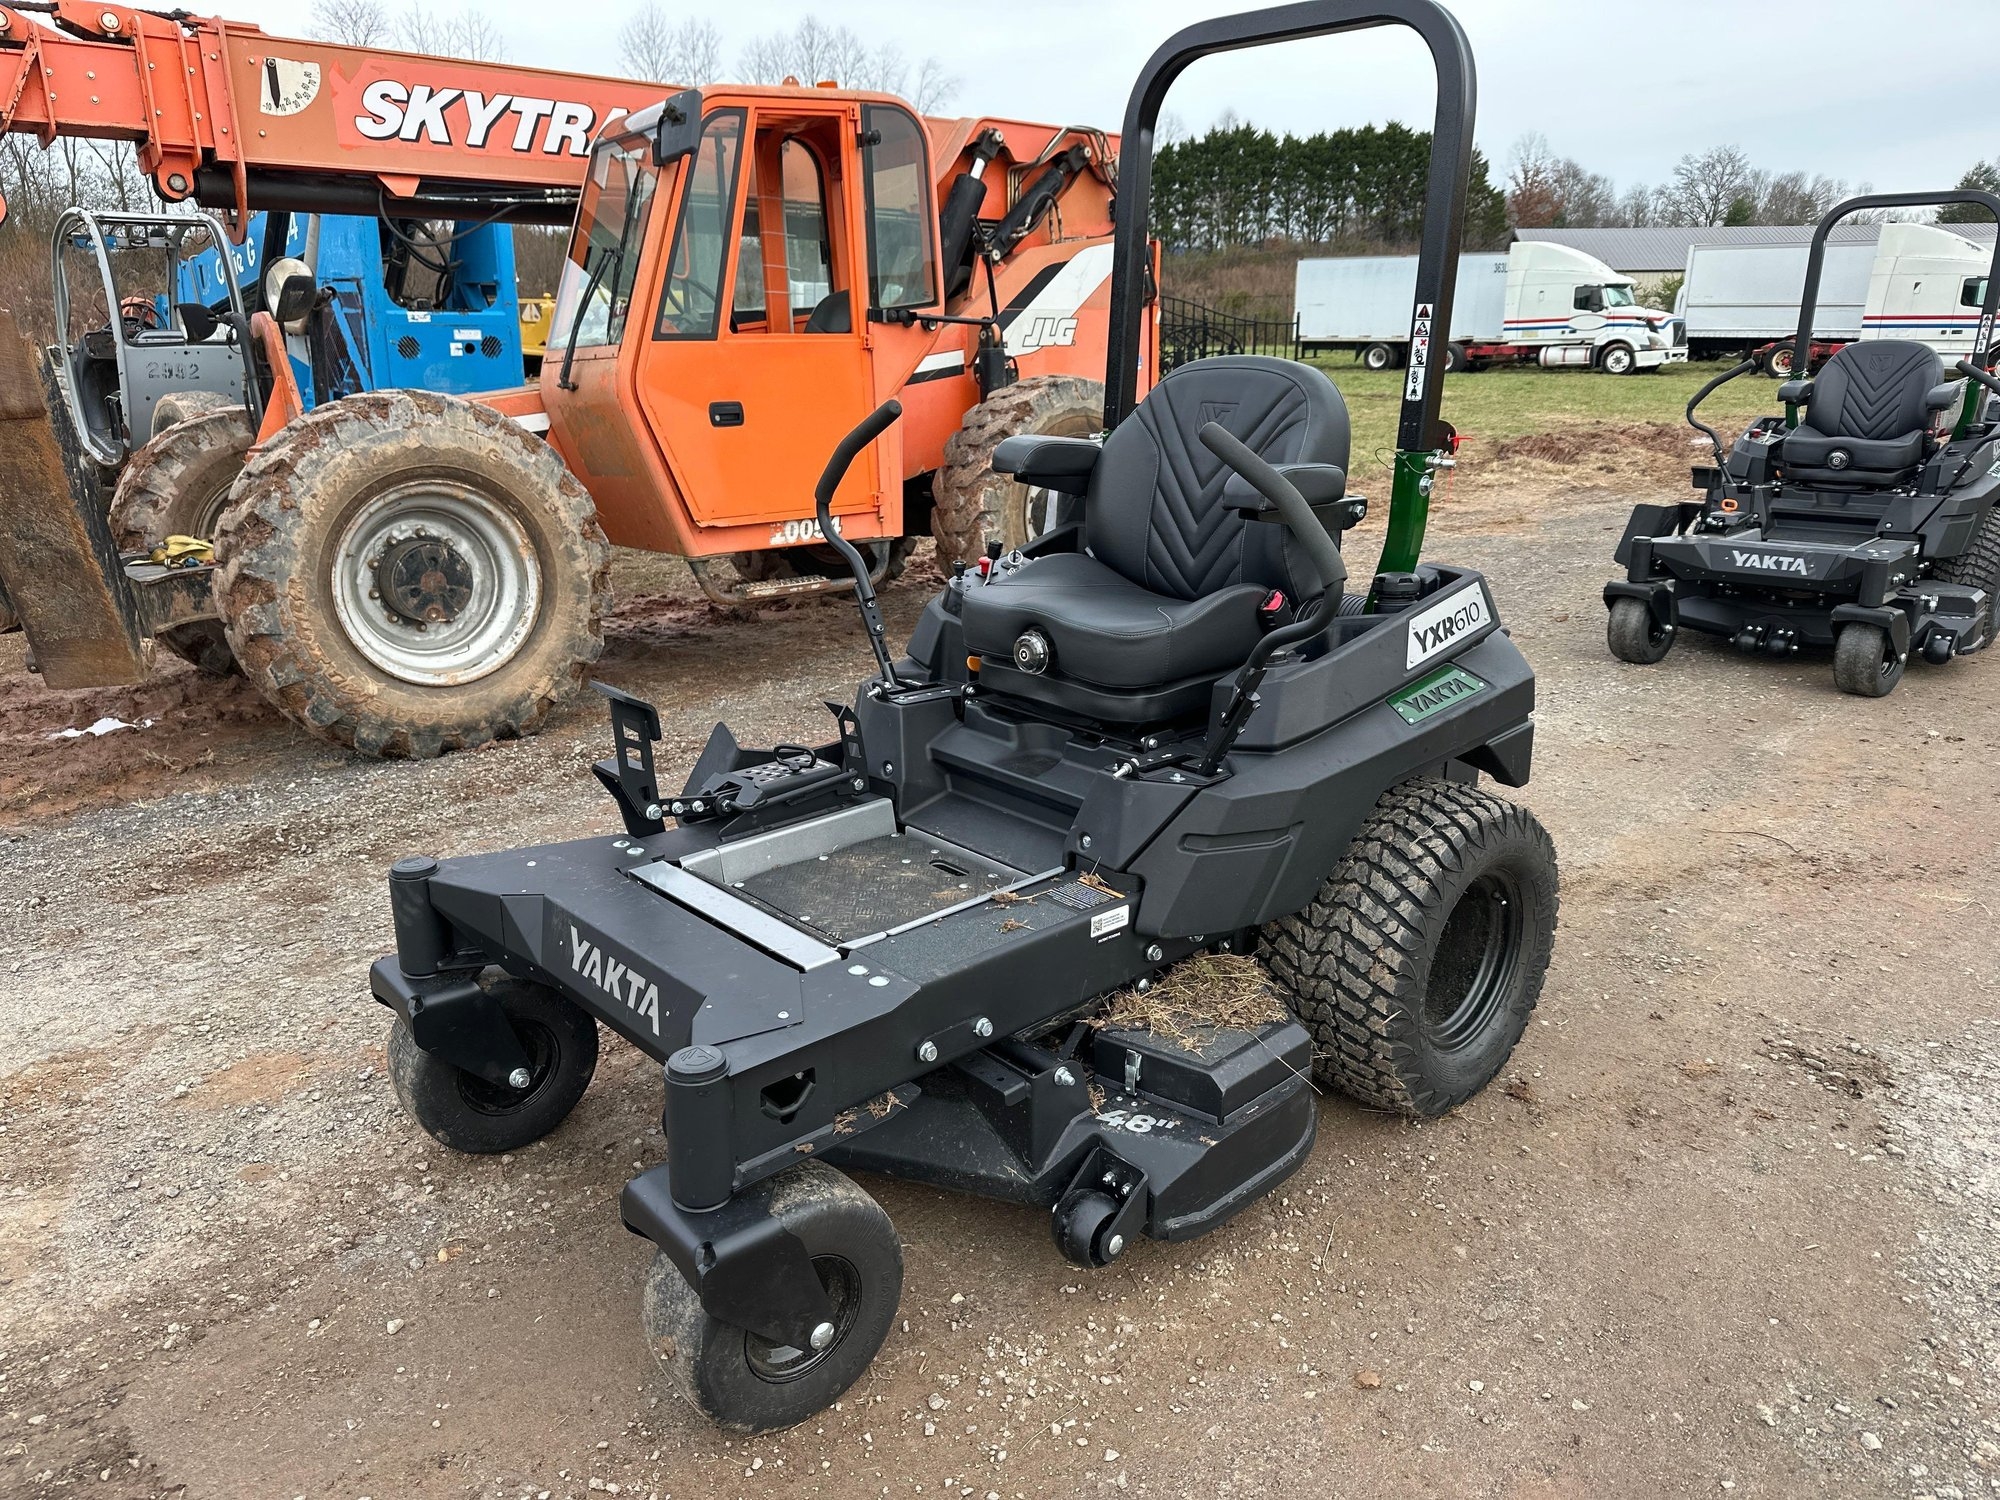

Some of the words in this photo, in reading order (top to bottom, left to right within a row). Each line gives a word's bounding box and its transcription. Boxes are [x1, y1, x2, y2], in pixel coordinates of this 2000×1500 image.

[1022, 317, 1079, 348] JLG
[1732, 550, 1808, 576] YAKTA
[1413, 601, 1481, 655] YXR610
[1402, 677, 1477, 714] YAKTA
[570, 924, 660, 1037] YAKTA
